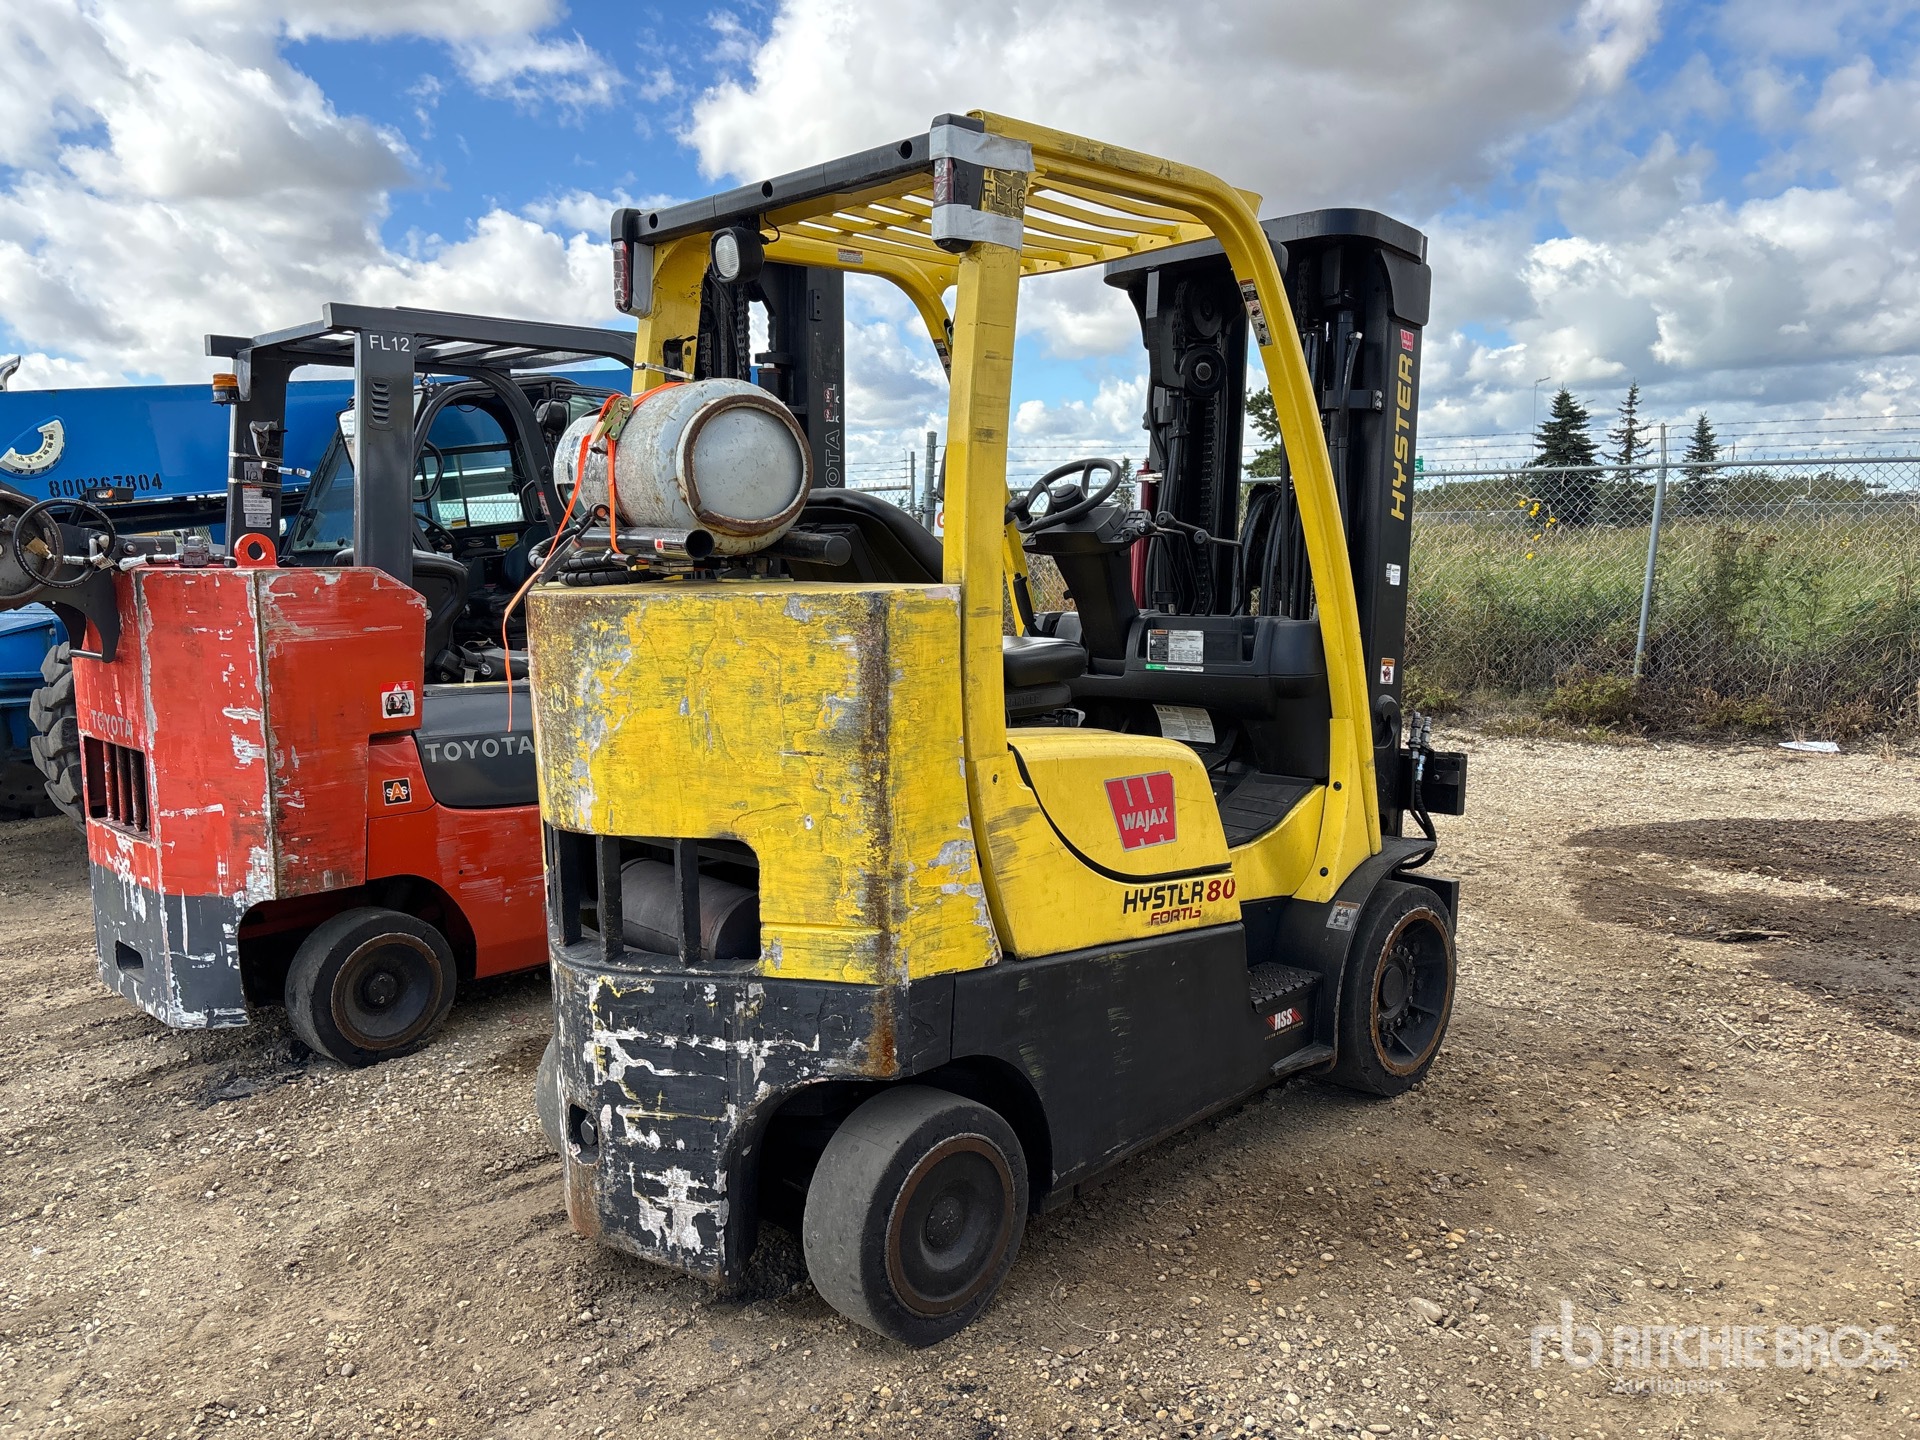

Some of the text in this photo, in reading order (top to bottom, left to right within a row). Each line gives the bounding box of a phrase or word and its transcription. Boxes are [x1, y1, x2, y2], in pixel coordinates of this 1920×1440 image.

[982, 179, 1025, 211] FL16
[369, 334, 411, 352] FL12
[1390, 353, 1413, 521] HYSTER
[90, 709, 134, 740] TOYOTA
[424, 735, 535, 763] TOYOTA
[385, 781, 409, 801] SAS
[1121, 806, 1169, 833] WAJAX
[1206, 877, 1236, 902] 80
[1274, 1007, 1293, 1031] HSS
